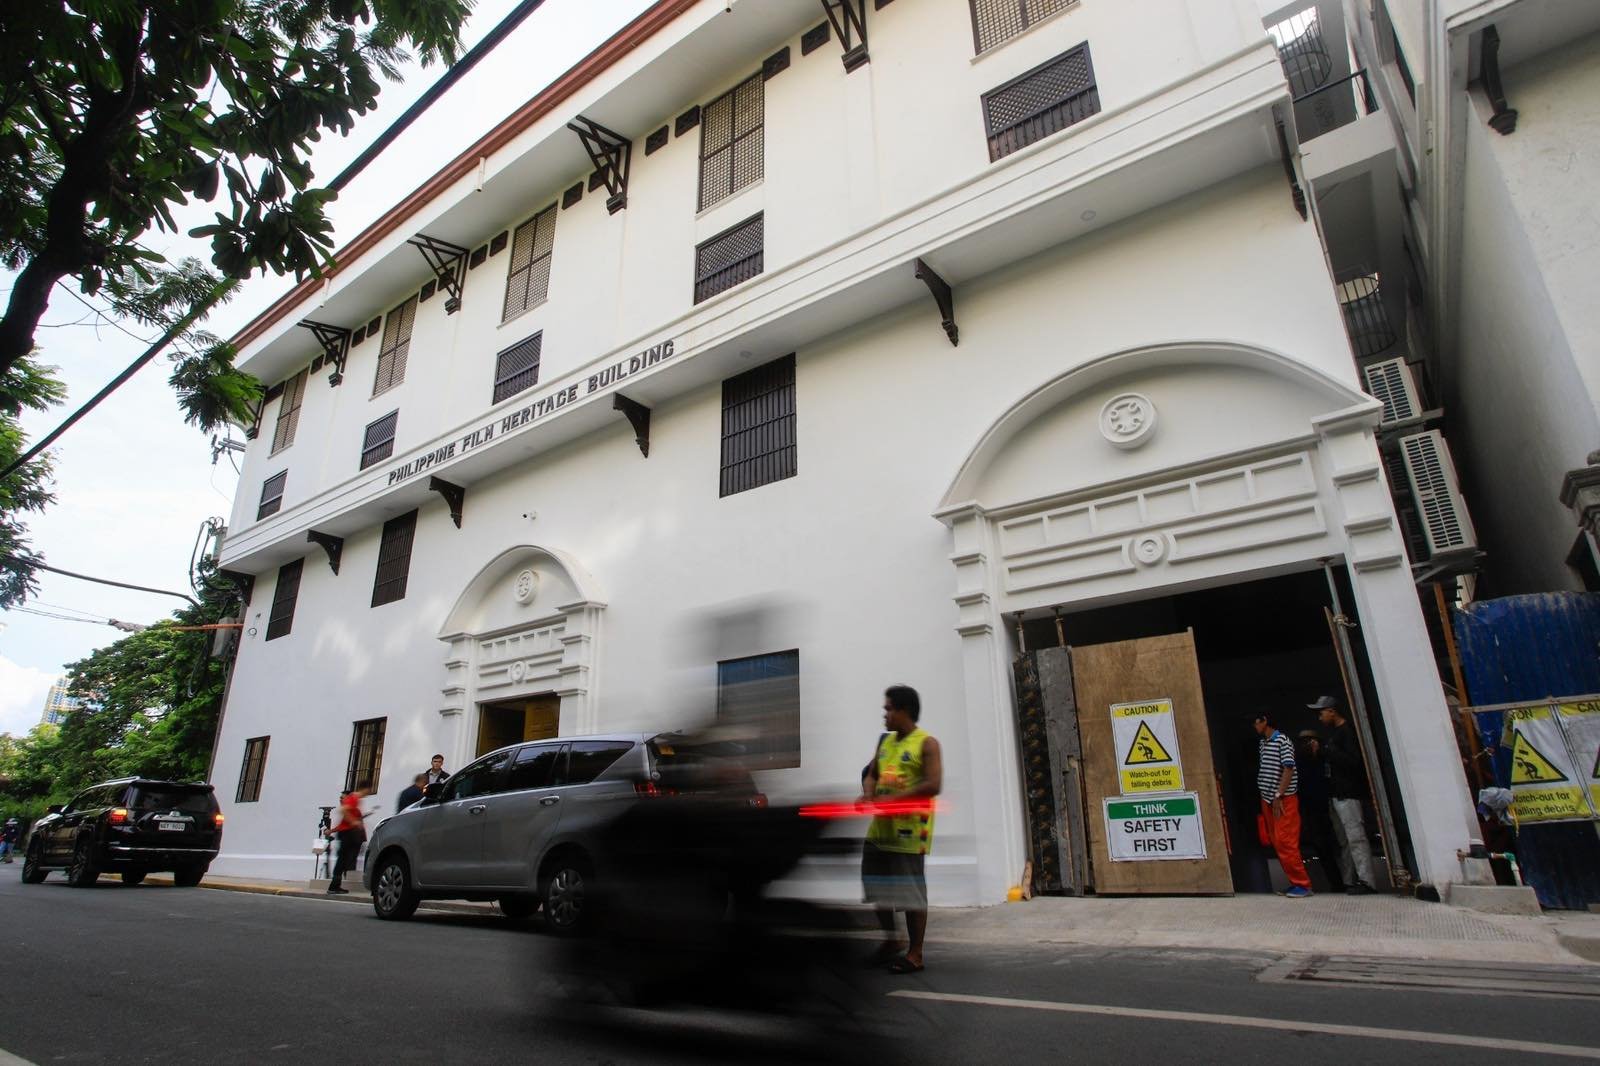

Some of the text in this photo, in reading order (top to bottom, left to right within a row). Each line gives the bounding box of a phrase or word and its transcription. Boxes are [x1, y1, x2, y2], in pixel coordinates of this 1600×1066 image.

[388, 339, 674, 486] PHILIPPINE FILM HERITAGE BUILDING
[1124, 704, 1159, 716] CAUTION
[1129, 769, 1171, 779] Watch-out for
[1131, 779, 1172, 789] falling debris
[1555, 791, 1570, 800] for
[1133, 804, 1168, 815] THINK
[1544, 804, 1576, 814] debris
[1124, 818, 1181, 834] SAFETY
[1133, 838, 1177, 852] FIRST
